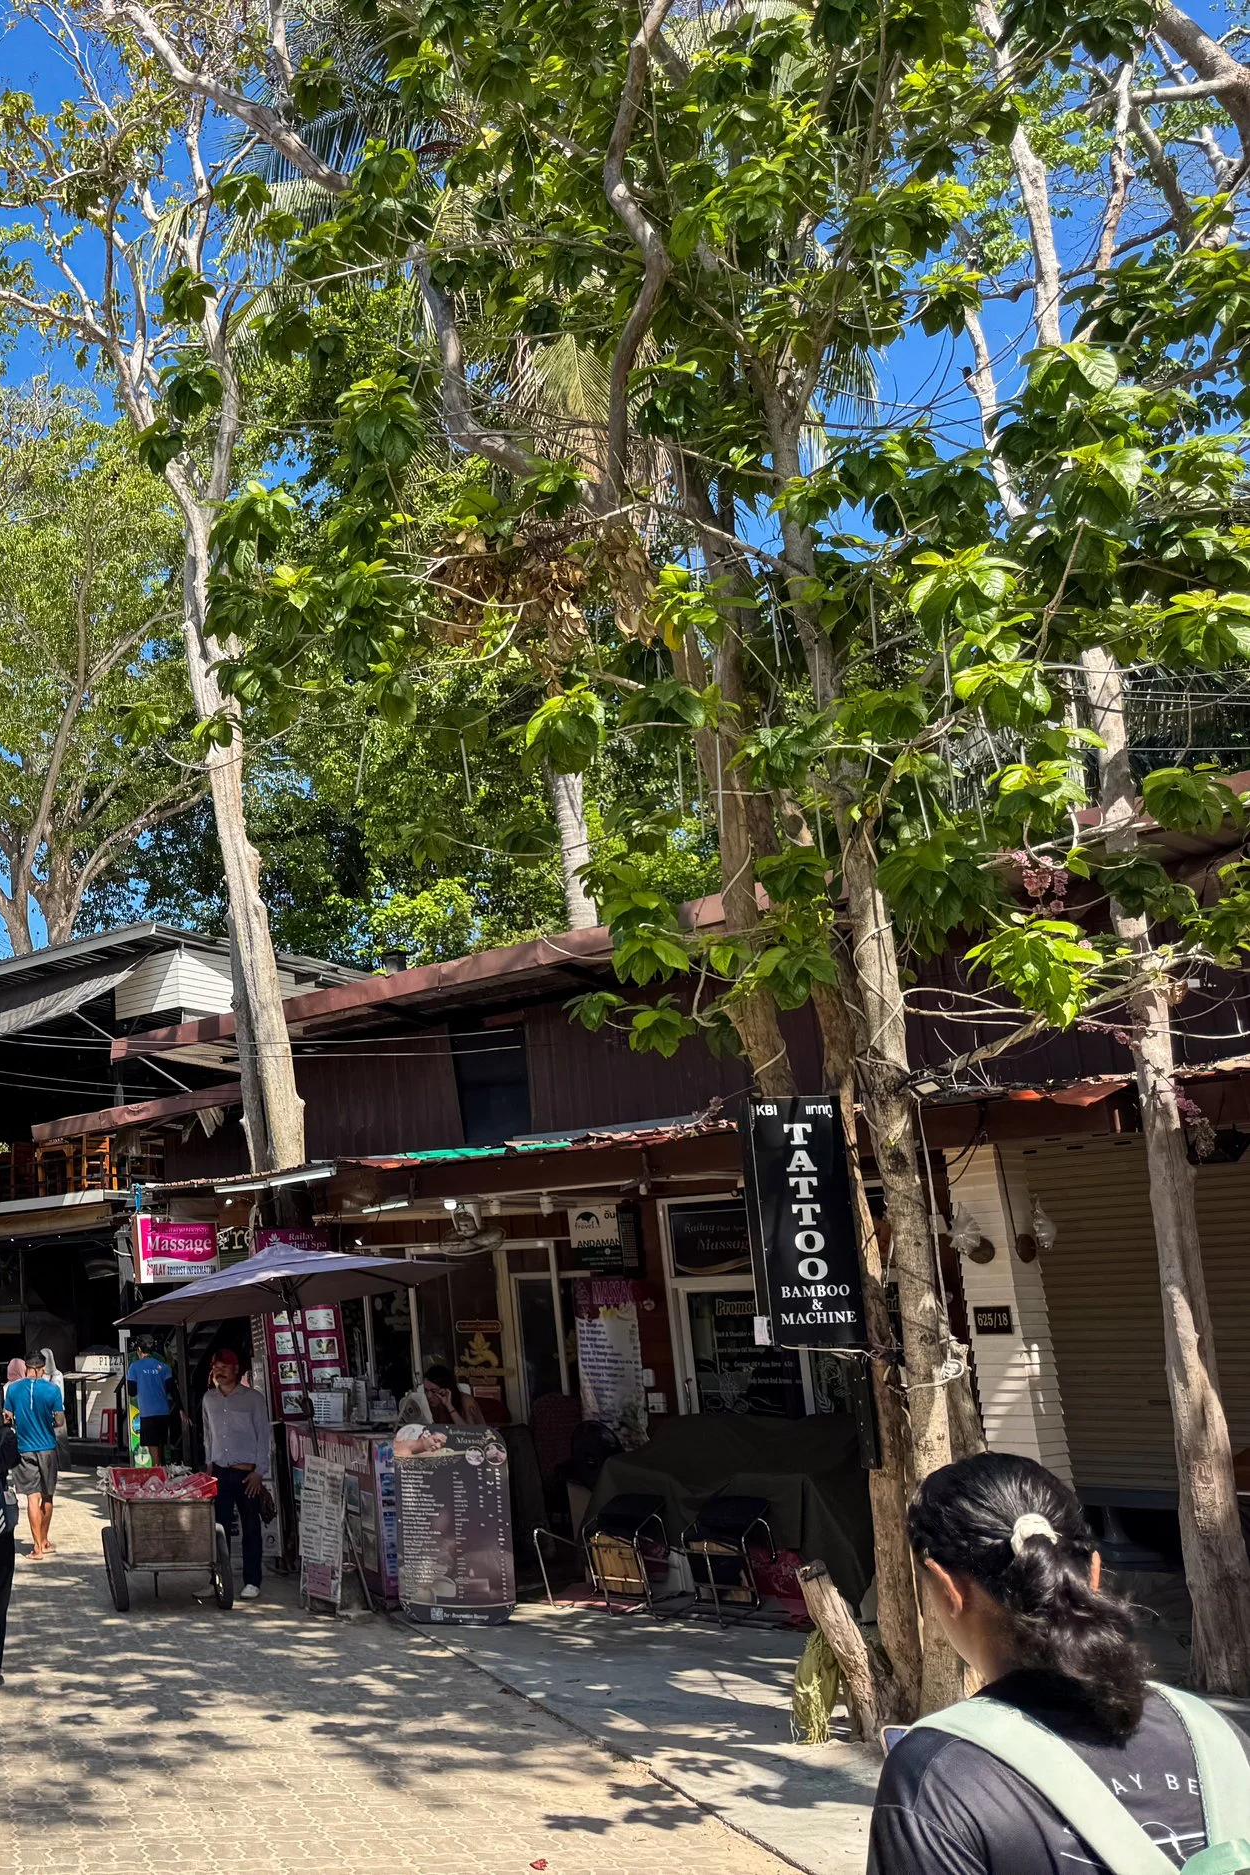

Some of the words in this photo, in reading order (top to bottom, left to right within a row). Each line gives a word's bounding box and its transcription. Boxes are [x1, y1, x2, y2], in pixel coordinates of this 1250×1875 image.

[755, 1104, 778, 1116] KBI
[783, 1123, 829, 1281] TATTOO
[288, 1232, 315, 1242] Railay
[577, 1238, 621, 1248] ANDAMAN
[146, 1235, 212, 1255] Massage
[310, 1240, 327, 1250] Spa
[696, 1237, 749, 1253] Massag
[167, 1265, 186, 1276] TOURIST
[186, 1264, 217, 1275] INFORMATION
[781, 1284, 850, 1299] BAMBOO
[811, 1298, 824, 1311] &
[781, 1311, 857, 1326] MACHINE
[977, 1312, 1009, 1328] 625/18
[99, 1356, 125, 1366] PIZZA
[1111, 1773, 1143, 1795] AY
[1164, 1773, 1200, 1796] BE
